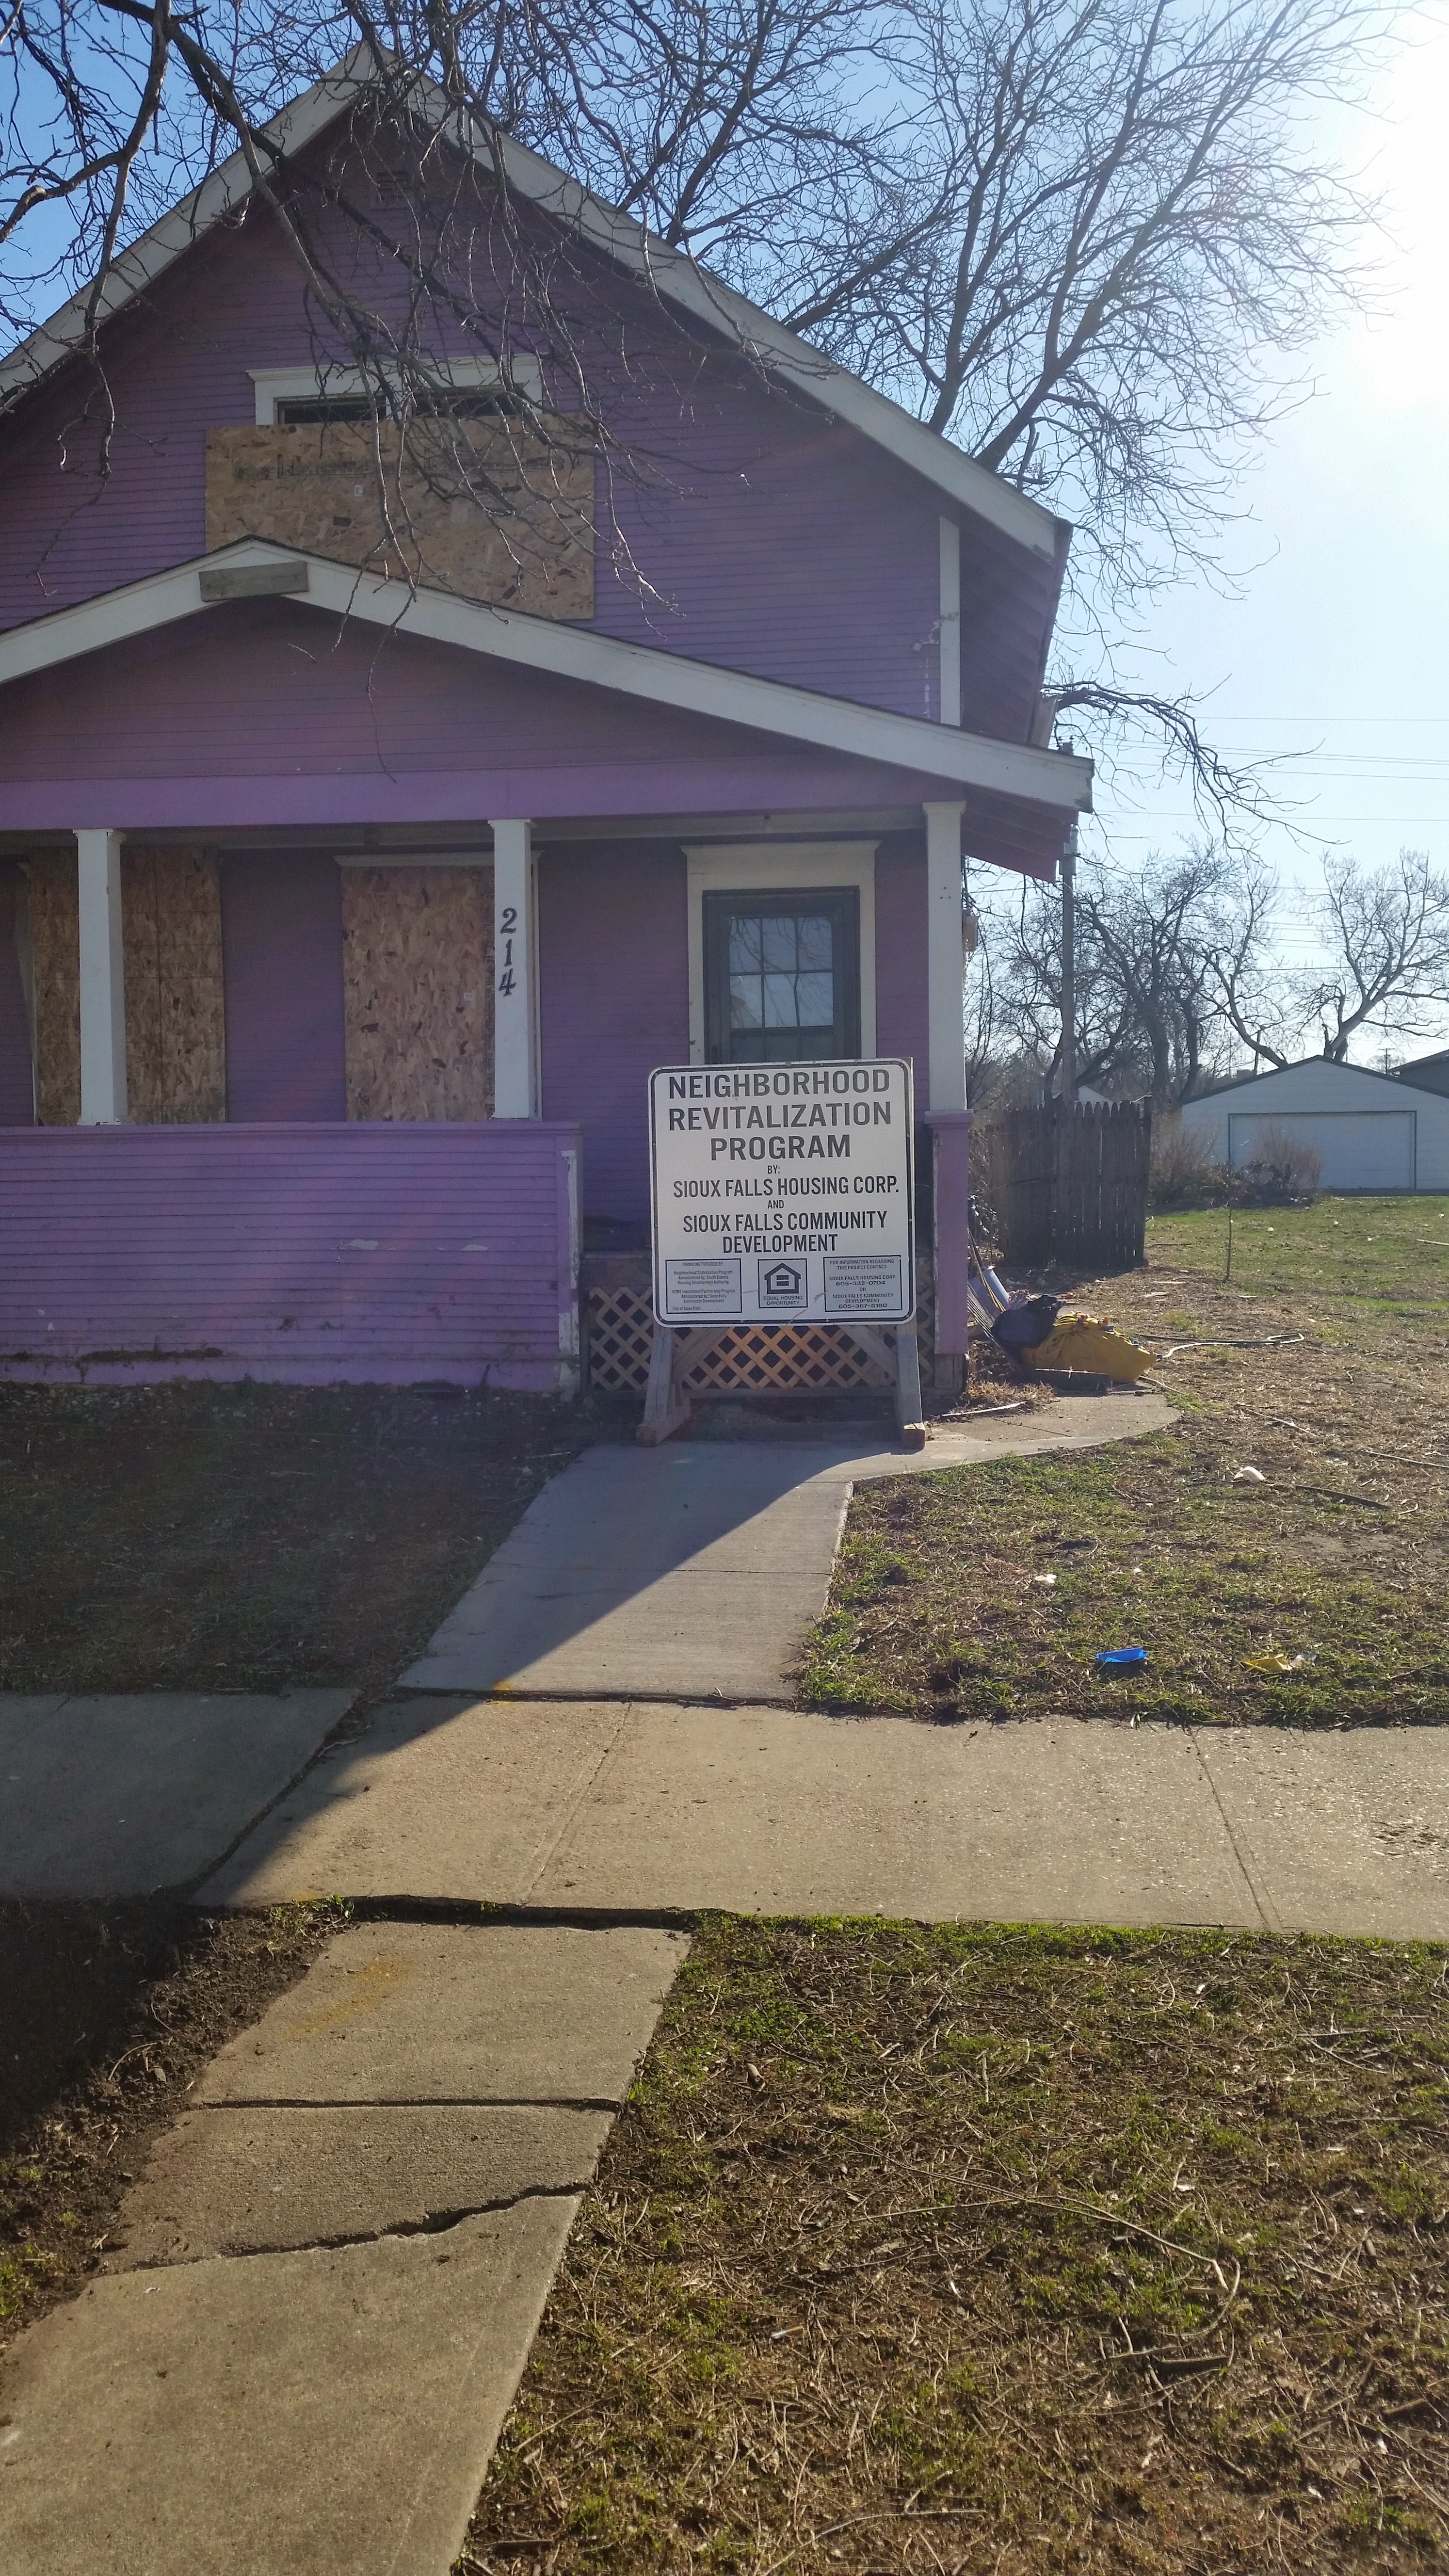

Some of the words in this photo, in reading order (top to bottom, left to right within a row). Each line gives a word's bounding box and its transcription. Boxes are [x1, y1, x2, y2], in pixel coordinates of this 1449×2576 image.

[669, 1069, 890, 1099] NEIGHBORHOOD
[669, 1101, 891, 1131] REVITALIZATION
[710, 1134, 851, 1160] PROGRAM
[767, 1165, 780, 1175] BY:
[673, 1180, 721, 1198] SIOUX
[725, 1178, 773, 1197] FALLS
[777, 1176, 849, 1195] HOUSING
[853, 1175, 899, 1193] CORP.
[767, 1200, 785, 1209] AND
[683, 1214, 731, 1233] SIOUX
[736, 1213, 783, 1231] FALLS
[788, 1211, 887, 1230] COMMUNITY
[723, 1234, 838, 1254] DEVELOPMENT
